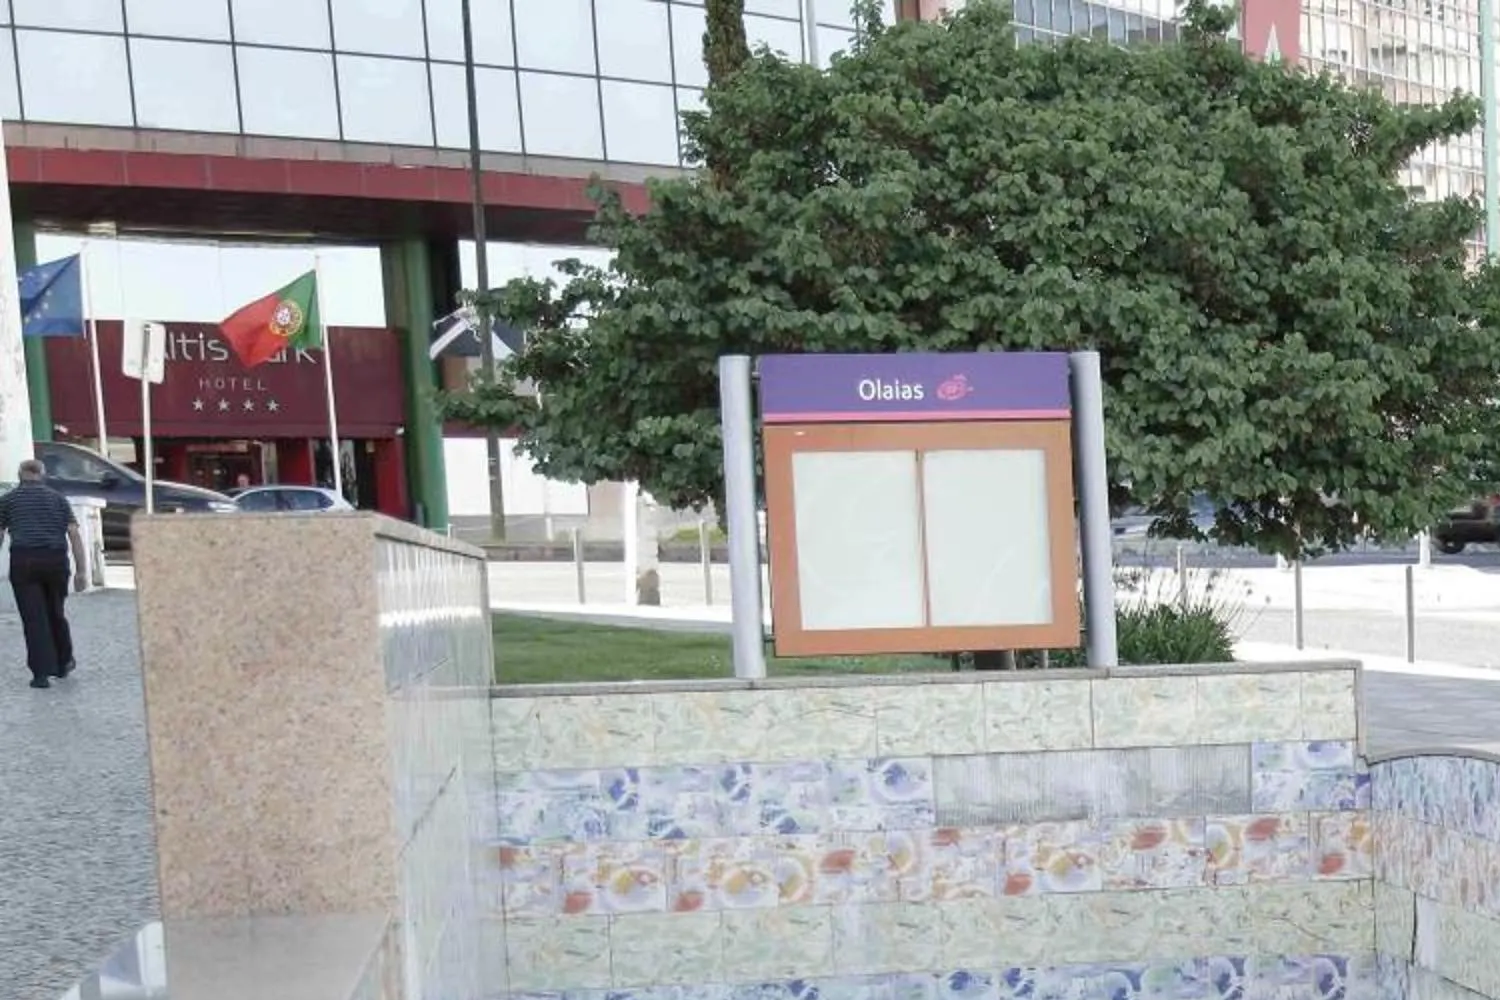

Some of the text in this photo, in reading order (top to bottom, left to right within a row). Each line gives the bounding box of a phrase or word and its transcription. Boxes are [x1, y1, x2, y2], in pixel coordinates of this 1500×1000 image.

[164, 331, 229, 361] ltis
[199, 376, 267, 392] HOTEL
[858, 378, 925, 401] Olaias
